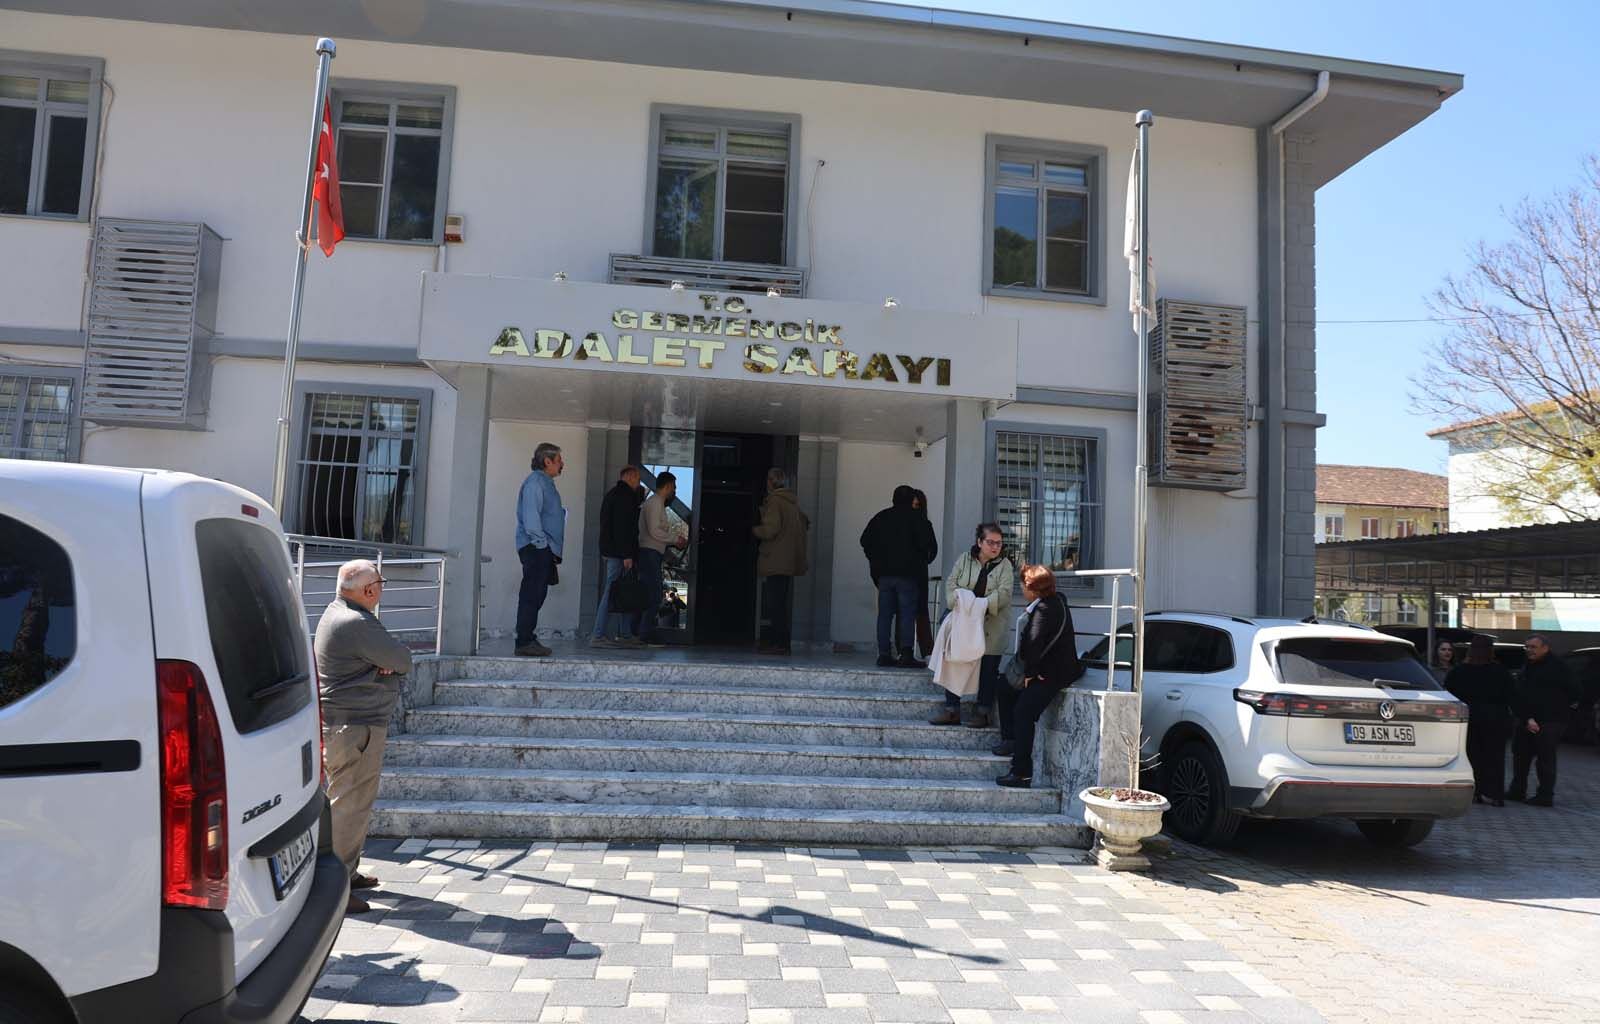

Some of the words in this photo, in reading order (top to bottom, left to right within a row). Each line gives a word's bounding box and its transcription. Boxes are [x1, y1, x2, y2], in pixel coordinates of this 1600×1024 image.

[698, 294, 752, 314] T.C.
[611, 308, 843, 346] GERMENCİK
[488, 326, 726, 370] ADALET
[743, 343, 952, 387] SARAYI
[1352, 726, 1366, 739] 09
[1371, 727, 1390, 740] ASN
[1394, 727, 1413, 741] 456
